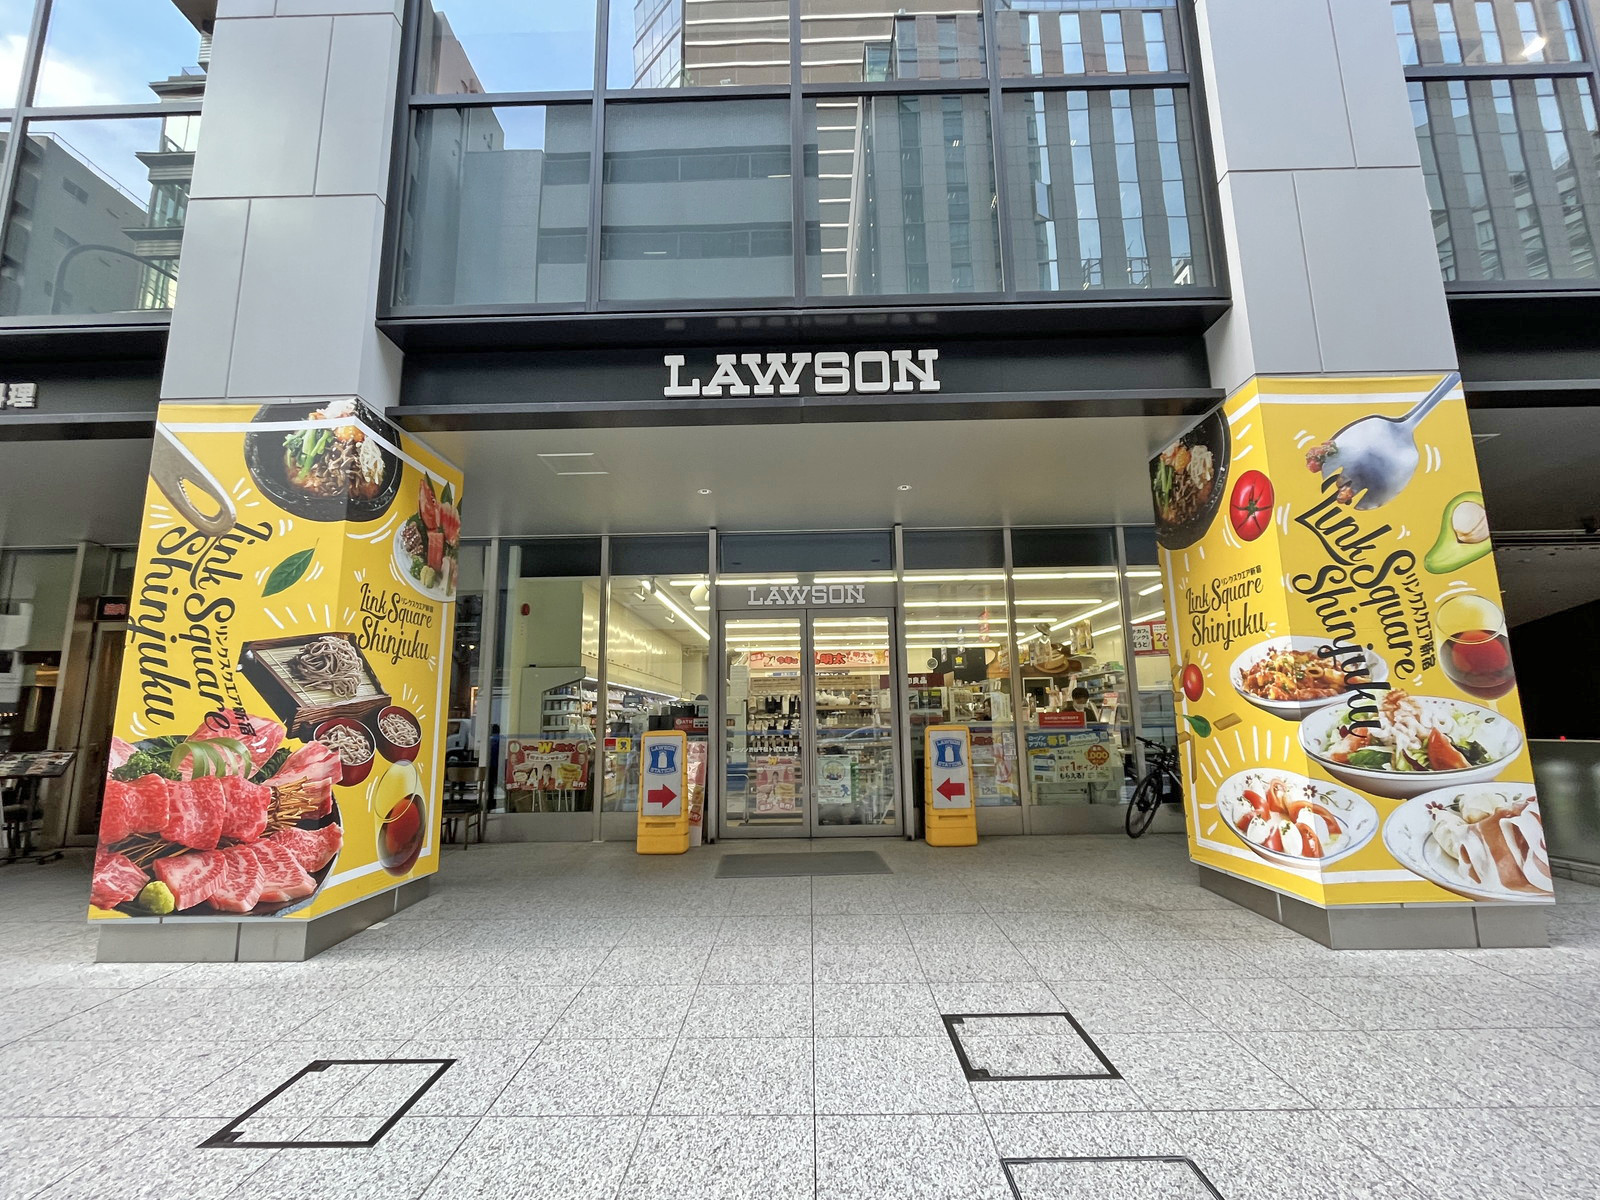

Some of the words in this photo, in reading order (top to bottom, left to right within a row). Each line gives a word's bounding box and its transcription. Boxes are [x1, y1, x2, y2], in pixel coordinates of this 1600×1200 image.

[0, 383, 36, 408] 理
[664, 349, 940, 397] LAWSON
[189, 522, 273, 590] Link
[1221, 565, 1262, 586] リンクスクエア新宿
[1294, 474, 1392, 566] Link
[1350, 549, 1416, 680] Square
[360, 583, 387, 621] Link
[387, 592, 433, 629] Square
[747, 584, 866, 606] LAWSON
[1185, 584, 1211, 615] Link
[1211, 578, 1264, 612] Square
[127, 526, 210, 726] Shinjuku
[358, 615, 430, 665] Shinjuku
[1192, 602, 1268, 651] Shinjuku
[1401, 572, 1436, 671] リンクスクエア新宿
[178, 593, 235, 733] Square
[1292, 564, 1391, 738] Shinjuku
[215, 625, 257, 737] リンクスクエア新宿
